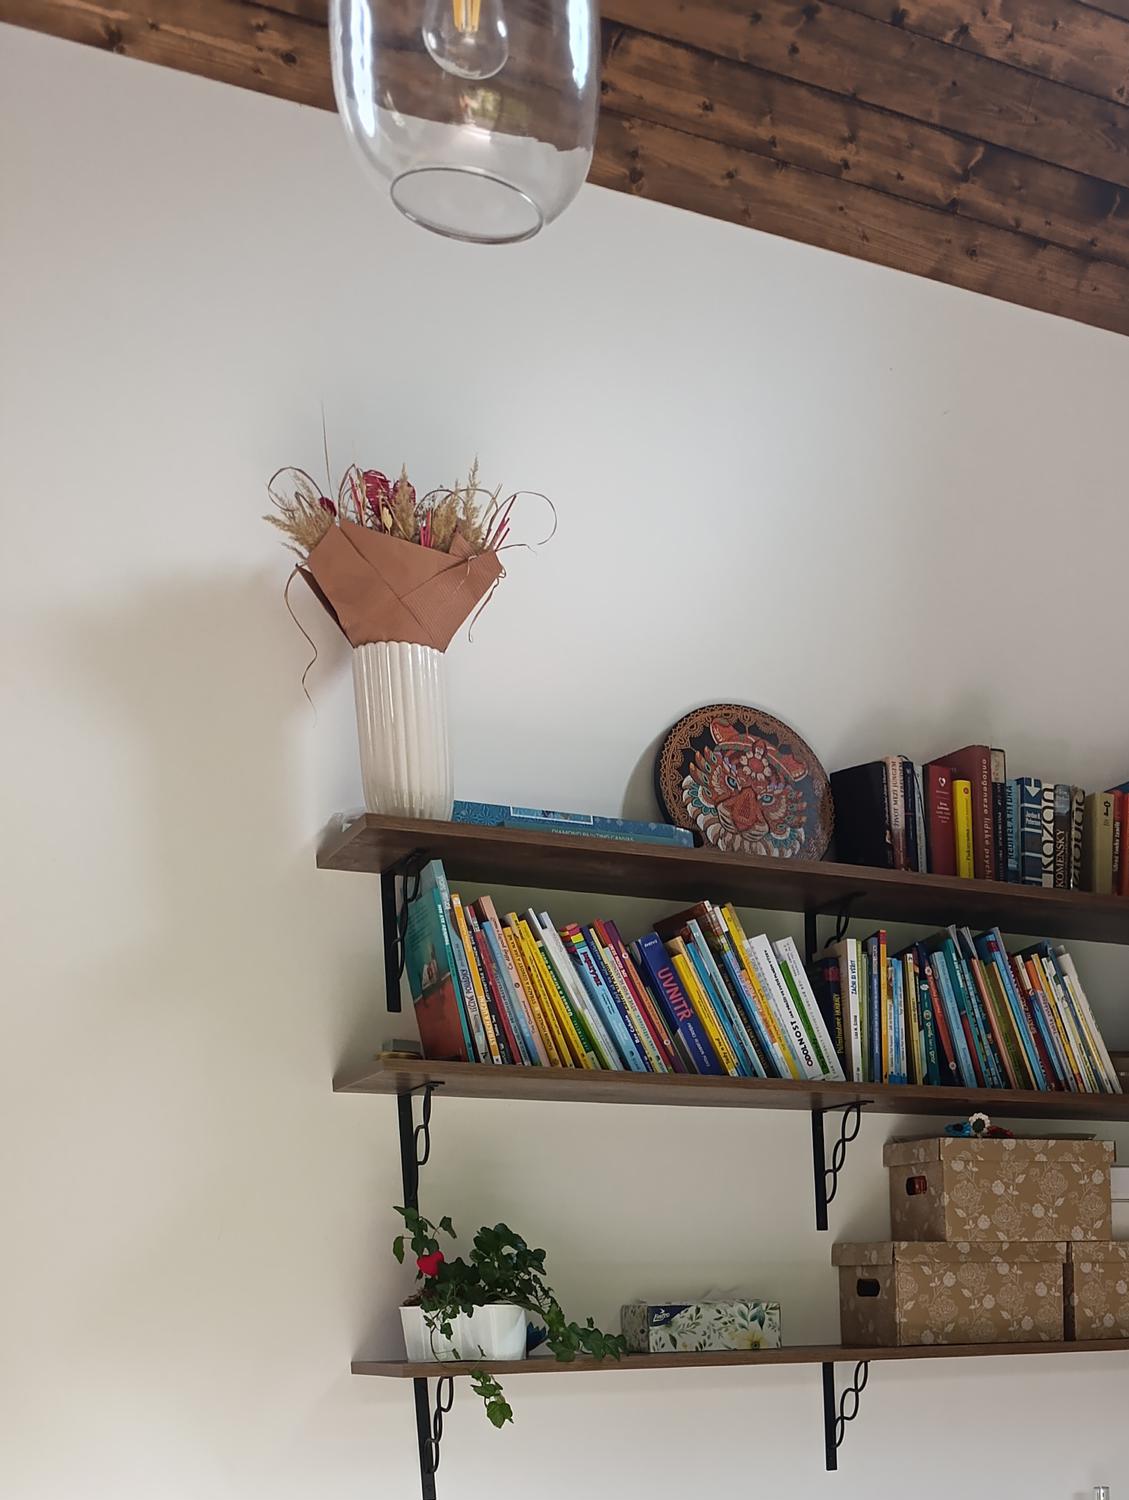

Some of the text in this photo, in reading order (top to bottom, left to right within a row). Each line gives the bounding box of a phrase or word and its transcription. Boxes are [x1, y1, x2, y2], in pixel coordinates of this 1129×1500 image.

[979, 758, 989, 814] ontogeneze
[983, 817, 992, 845] lidské
[655, 963, 695, 1022] UVNITŘ
[789, 1019, 814, 1067] ODOLNOST
